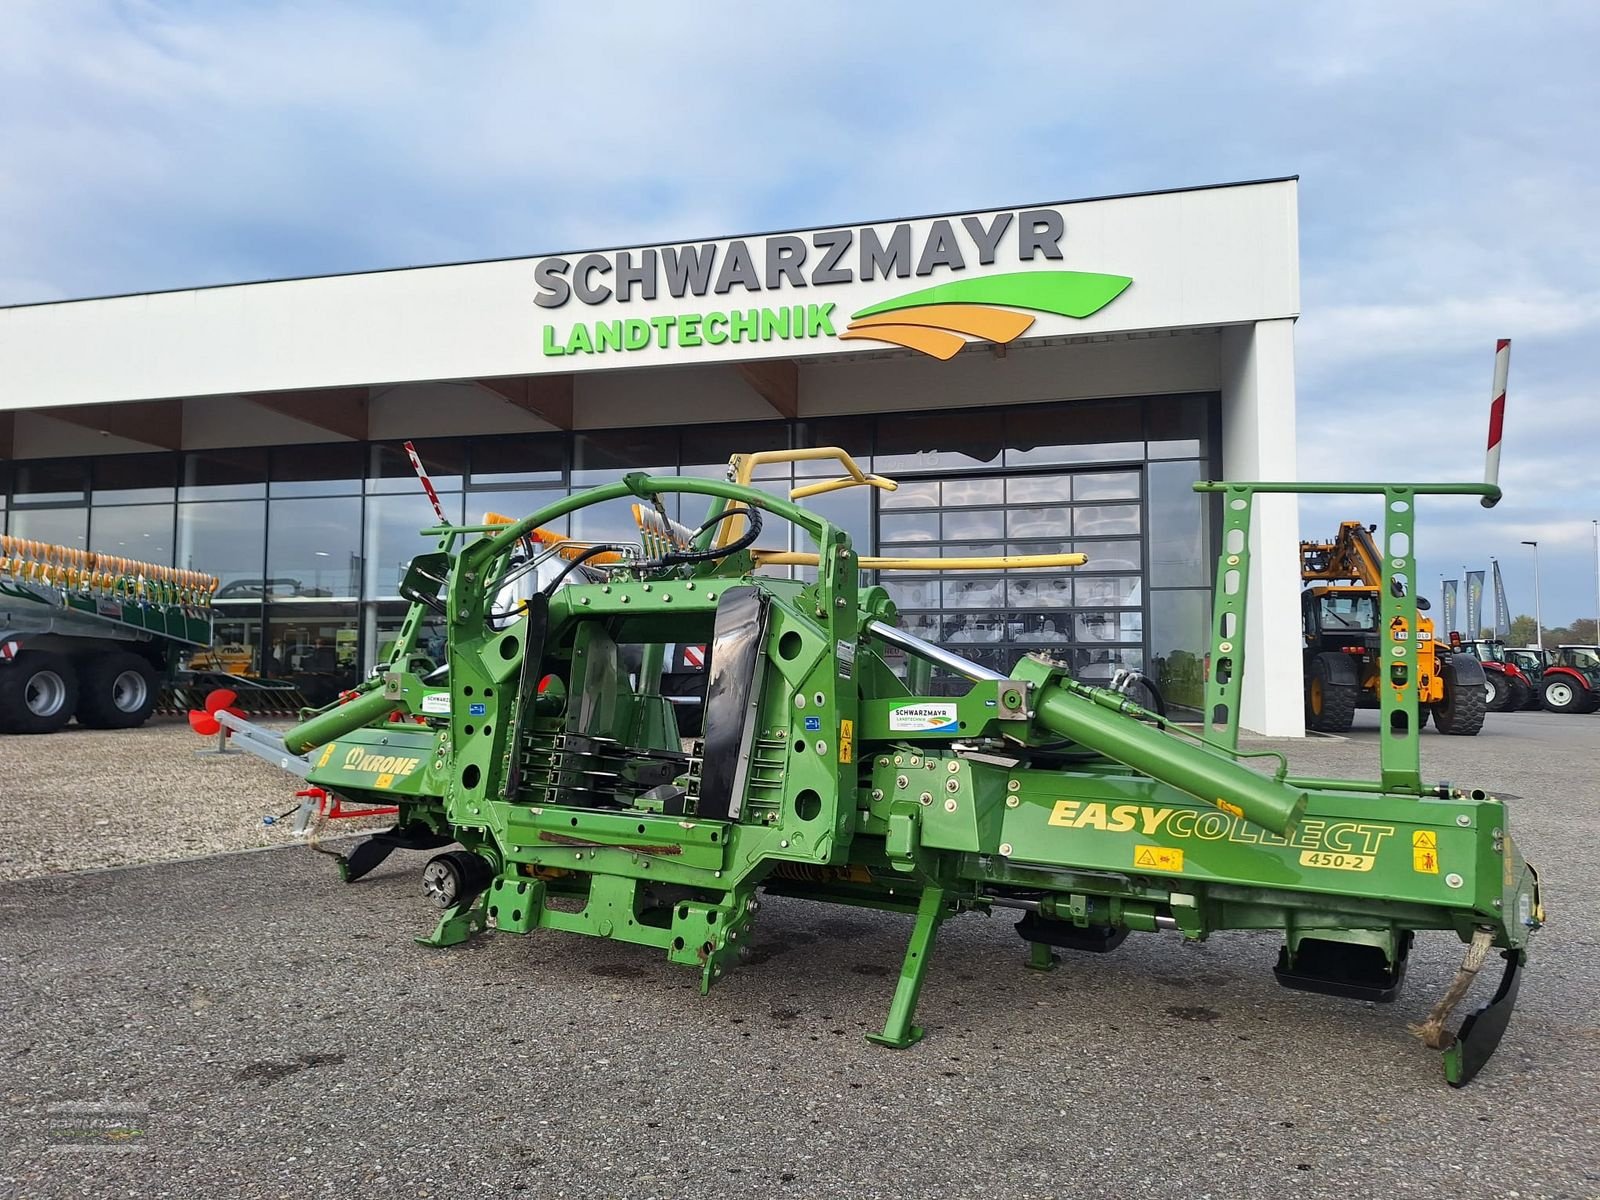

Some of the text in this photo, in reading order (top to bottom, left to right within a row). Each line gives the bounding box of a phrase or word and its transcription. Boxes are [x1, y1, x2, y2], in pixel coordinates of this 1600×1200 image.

[533, 208, 1065, 308] SCHWARZMAYR
[542, 302, 837, 357] LANDTECHNIK
[357, 754, 420, 776] KRONE
[1308, 852, 1364, 870] 450-2
